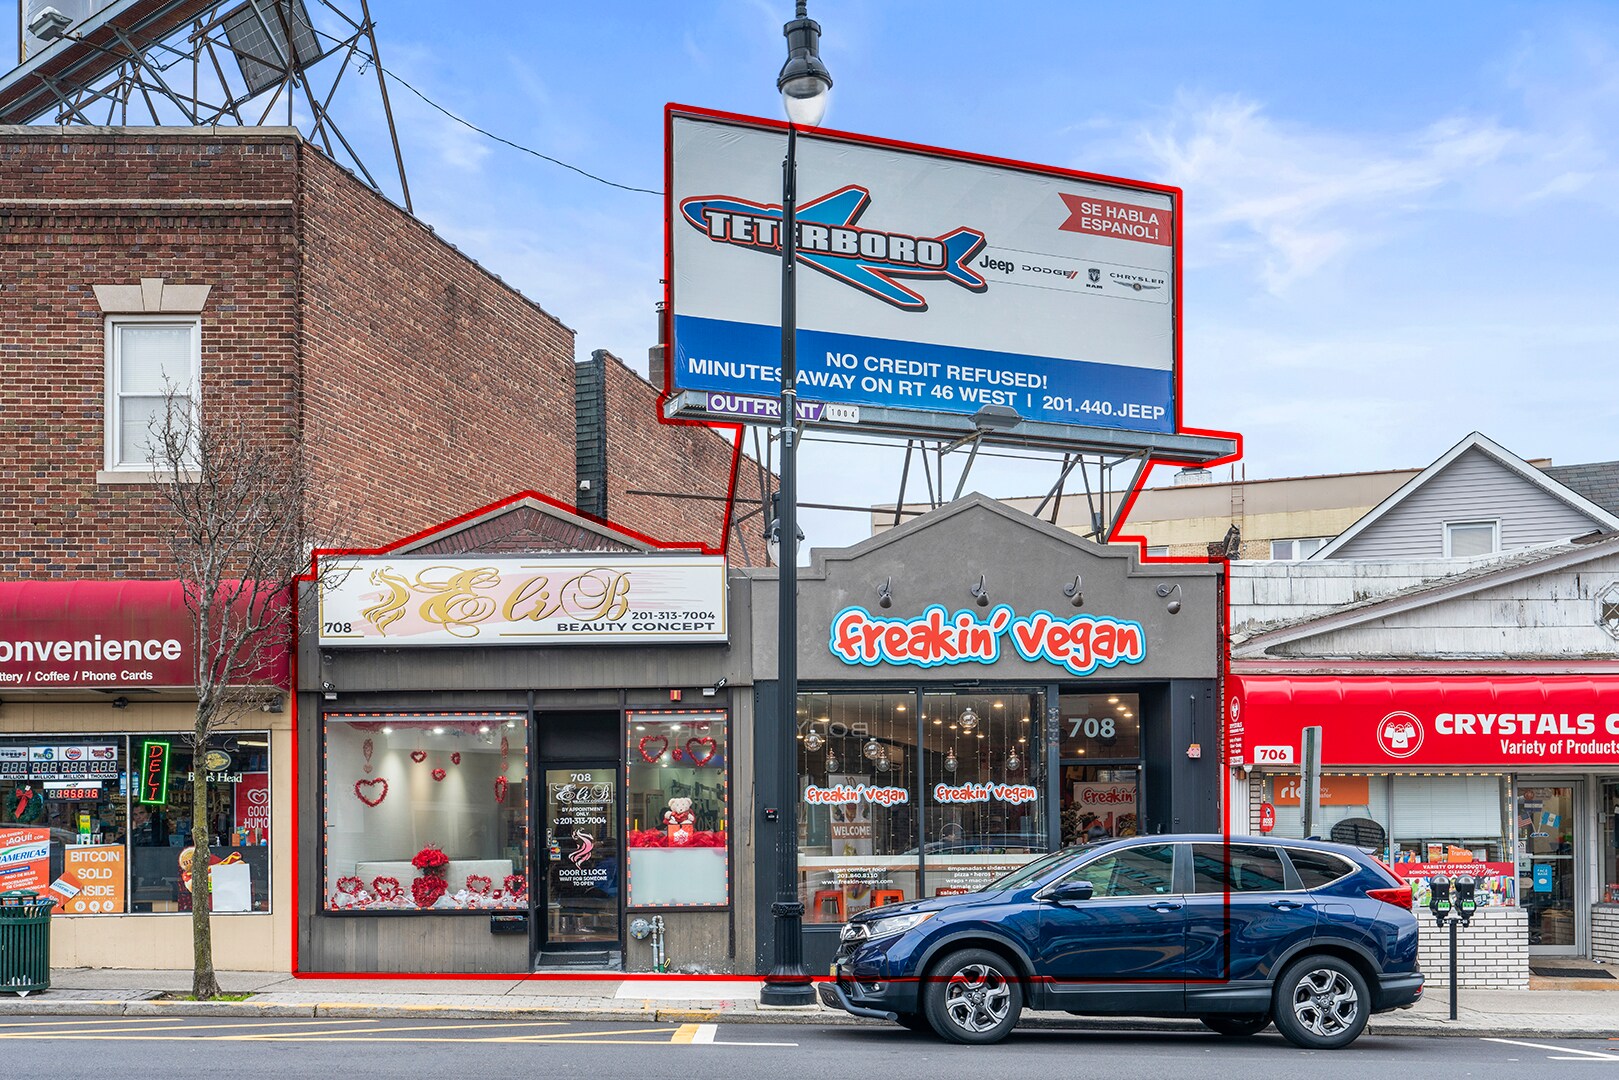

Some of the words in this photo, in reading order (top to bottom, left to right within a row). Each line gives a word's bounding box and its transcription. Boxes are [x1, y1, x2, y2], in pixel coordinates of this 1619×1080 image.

[1081, 202, 1103, 217] SE
[1106, 210, 1159, 226] HABLA
[1081, 216, 1160, 240] ESPANOL!
[705, 210, 943, 267] TETRBORO
[979, 254, 1015, 275] Jeep
[1021, 263, 1074, 278] DODGE
[1109, 271, 1165, 285] CHRYSLER
[826, 352, 858, 370] NO
[863, 355, 942, 378] CREDIT
[946, 364, 1048, 390] REFUSED!
[796, 369, 856, 390] AWAY
[861, 376, 893, 394] ON
[898, 380, 926, 397] RT
[930, 385, 954, 400] 46
[958, 385, 1018, 406] WEST
[1042, 396, 1166, 420] 201.440.JEEP
[710, 394, 820, 419] OUTFRNT
[631, 610, 716, 621] 201-313-7004
[324, 622, 353, 635] 708
[556, 622, 629, 633] BEAUTY
[631, 621, 715, 632] CONCEPT
[0, 634, 182, 662] onvenience
[34, 670, 71, 682] Coffee
[82, 670, 117, 681] Phone
[120, 670, 154, 681] Cards
[1068, 717, 1116, 738] 708
[1434, 712, 1596, 736] CRYSTALS
[1260, 749, 1287, 761] 706
[1500, 739, 1547, 757] Variety
[1550, 739, 1563, 755] of
[148, 745, 164, 801] DELI
[217, 772, 243, 783] Head
[570, 773, 592, 782] 708
[559, 816, 607, 825] 201-313-7004
[832, 825, 872, 836] WELCOME
[70, 851, 120, 863] BITCOIN
[77, 867, 113, 880] SOLD
[78, 884, 115, 897] NSIDE
